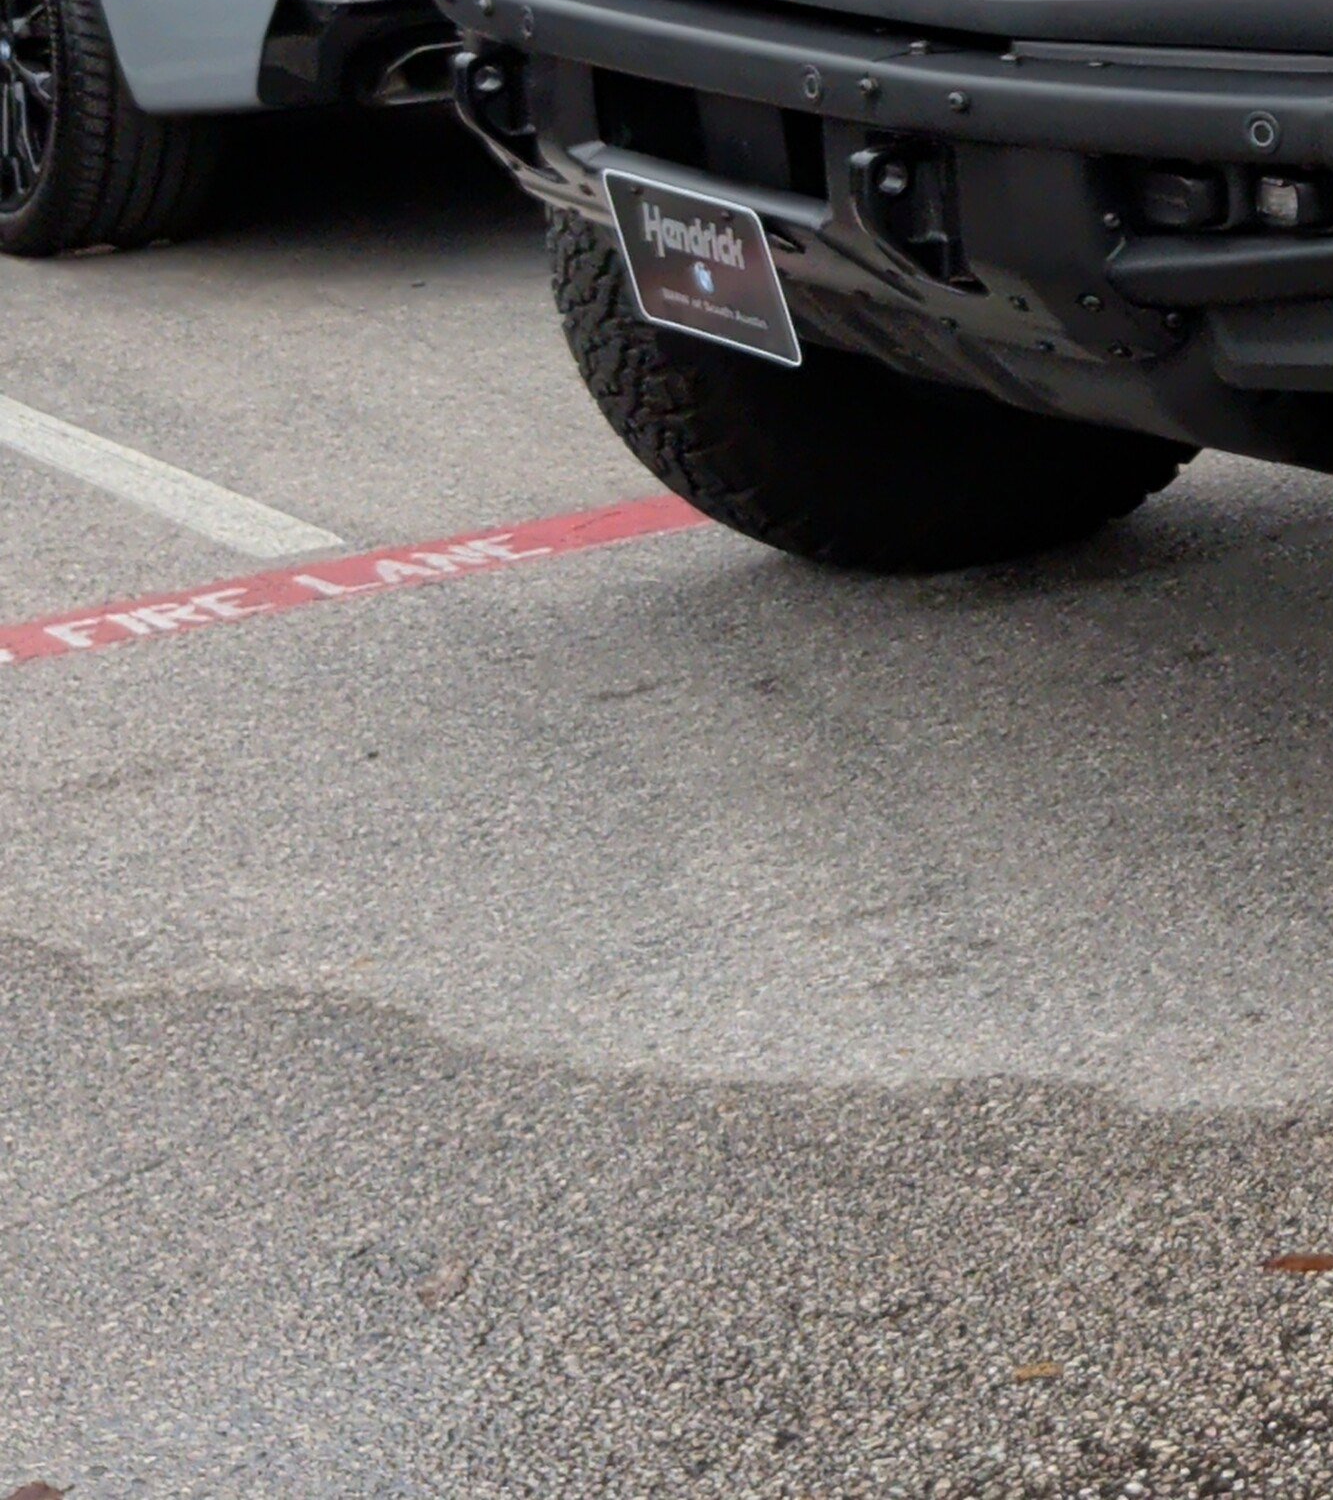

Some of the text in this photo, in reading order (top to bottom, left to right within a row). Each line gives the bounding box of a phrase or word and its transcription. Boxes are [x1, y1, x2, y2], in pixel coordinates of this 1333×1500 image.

[641, 201, 746, 270] Hendrick
[44, 532, 553, 648] FIRE LANE
